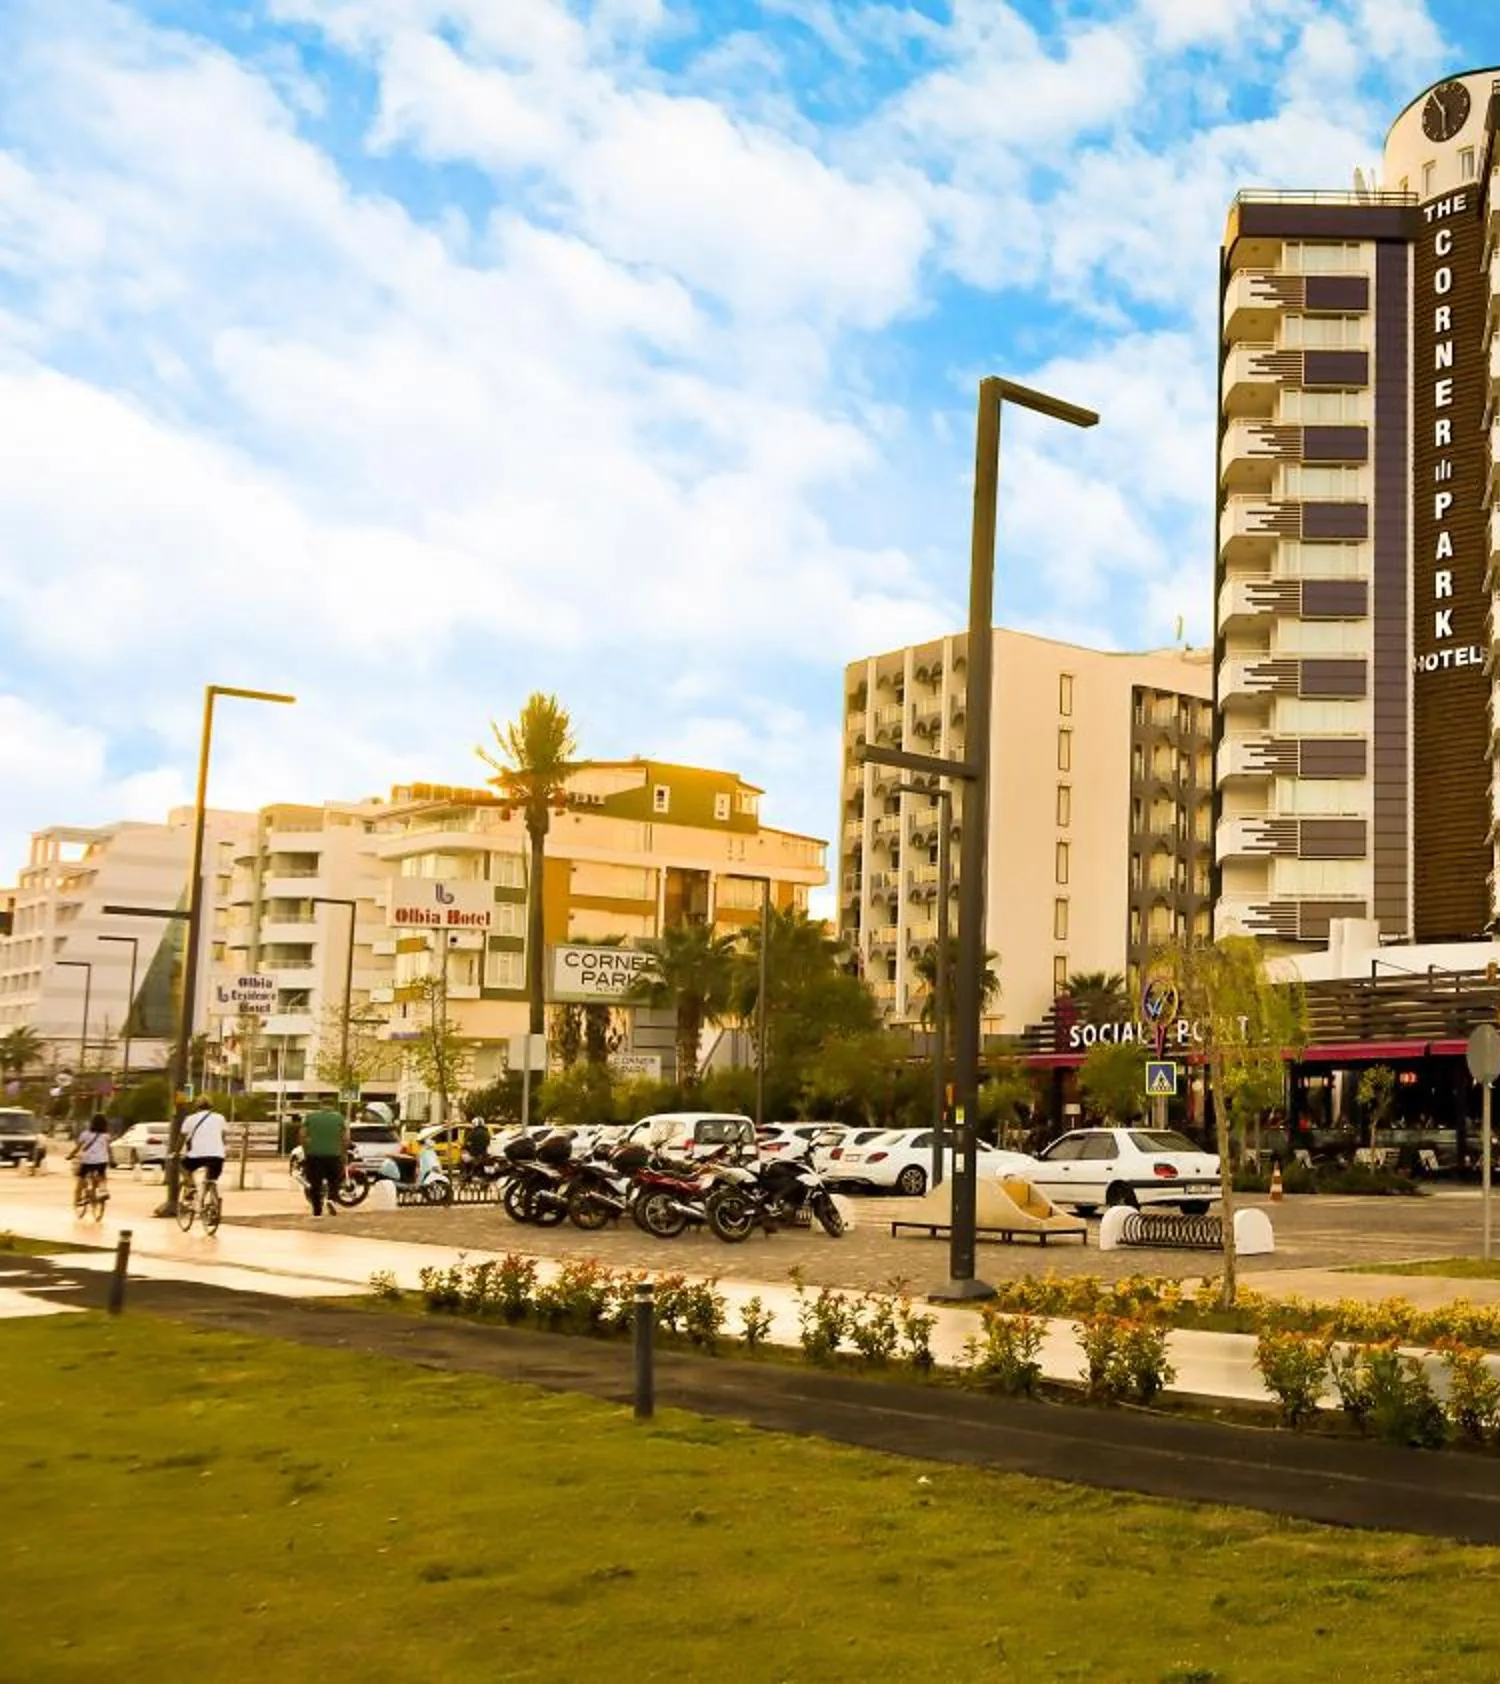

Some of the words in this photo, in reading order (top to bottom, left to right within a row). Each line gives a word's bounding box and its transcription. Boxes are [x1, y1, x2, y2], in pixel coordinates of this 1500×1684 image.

[1423, 193, 1467, 223] THE
[1434, 228, 1454, 447] CORNER
[1434, 491, 1454, 639] PARK
[395, 908, 441, 924] Olbia
[447, 909, 491, 925] Hotel
[581, 971, 638, 986] PARK
[1069, 1022, 1148, 1048] SOCIAL
[1177, 1015, 1249, 1043] PONT
